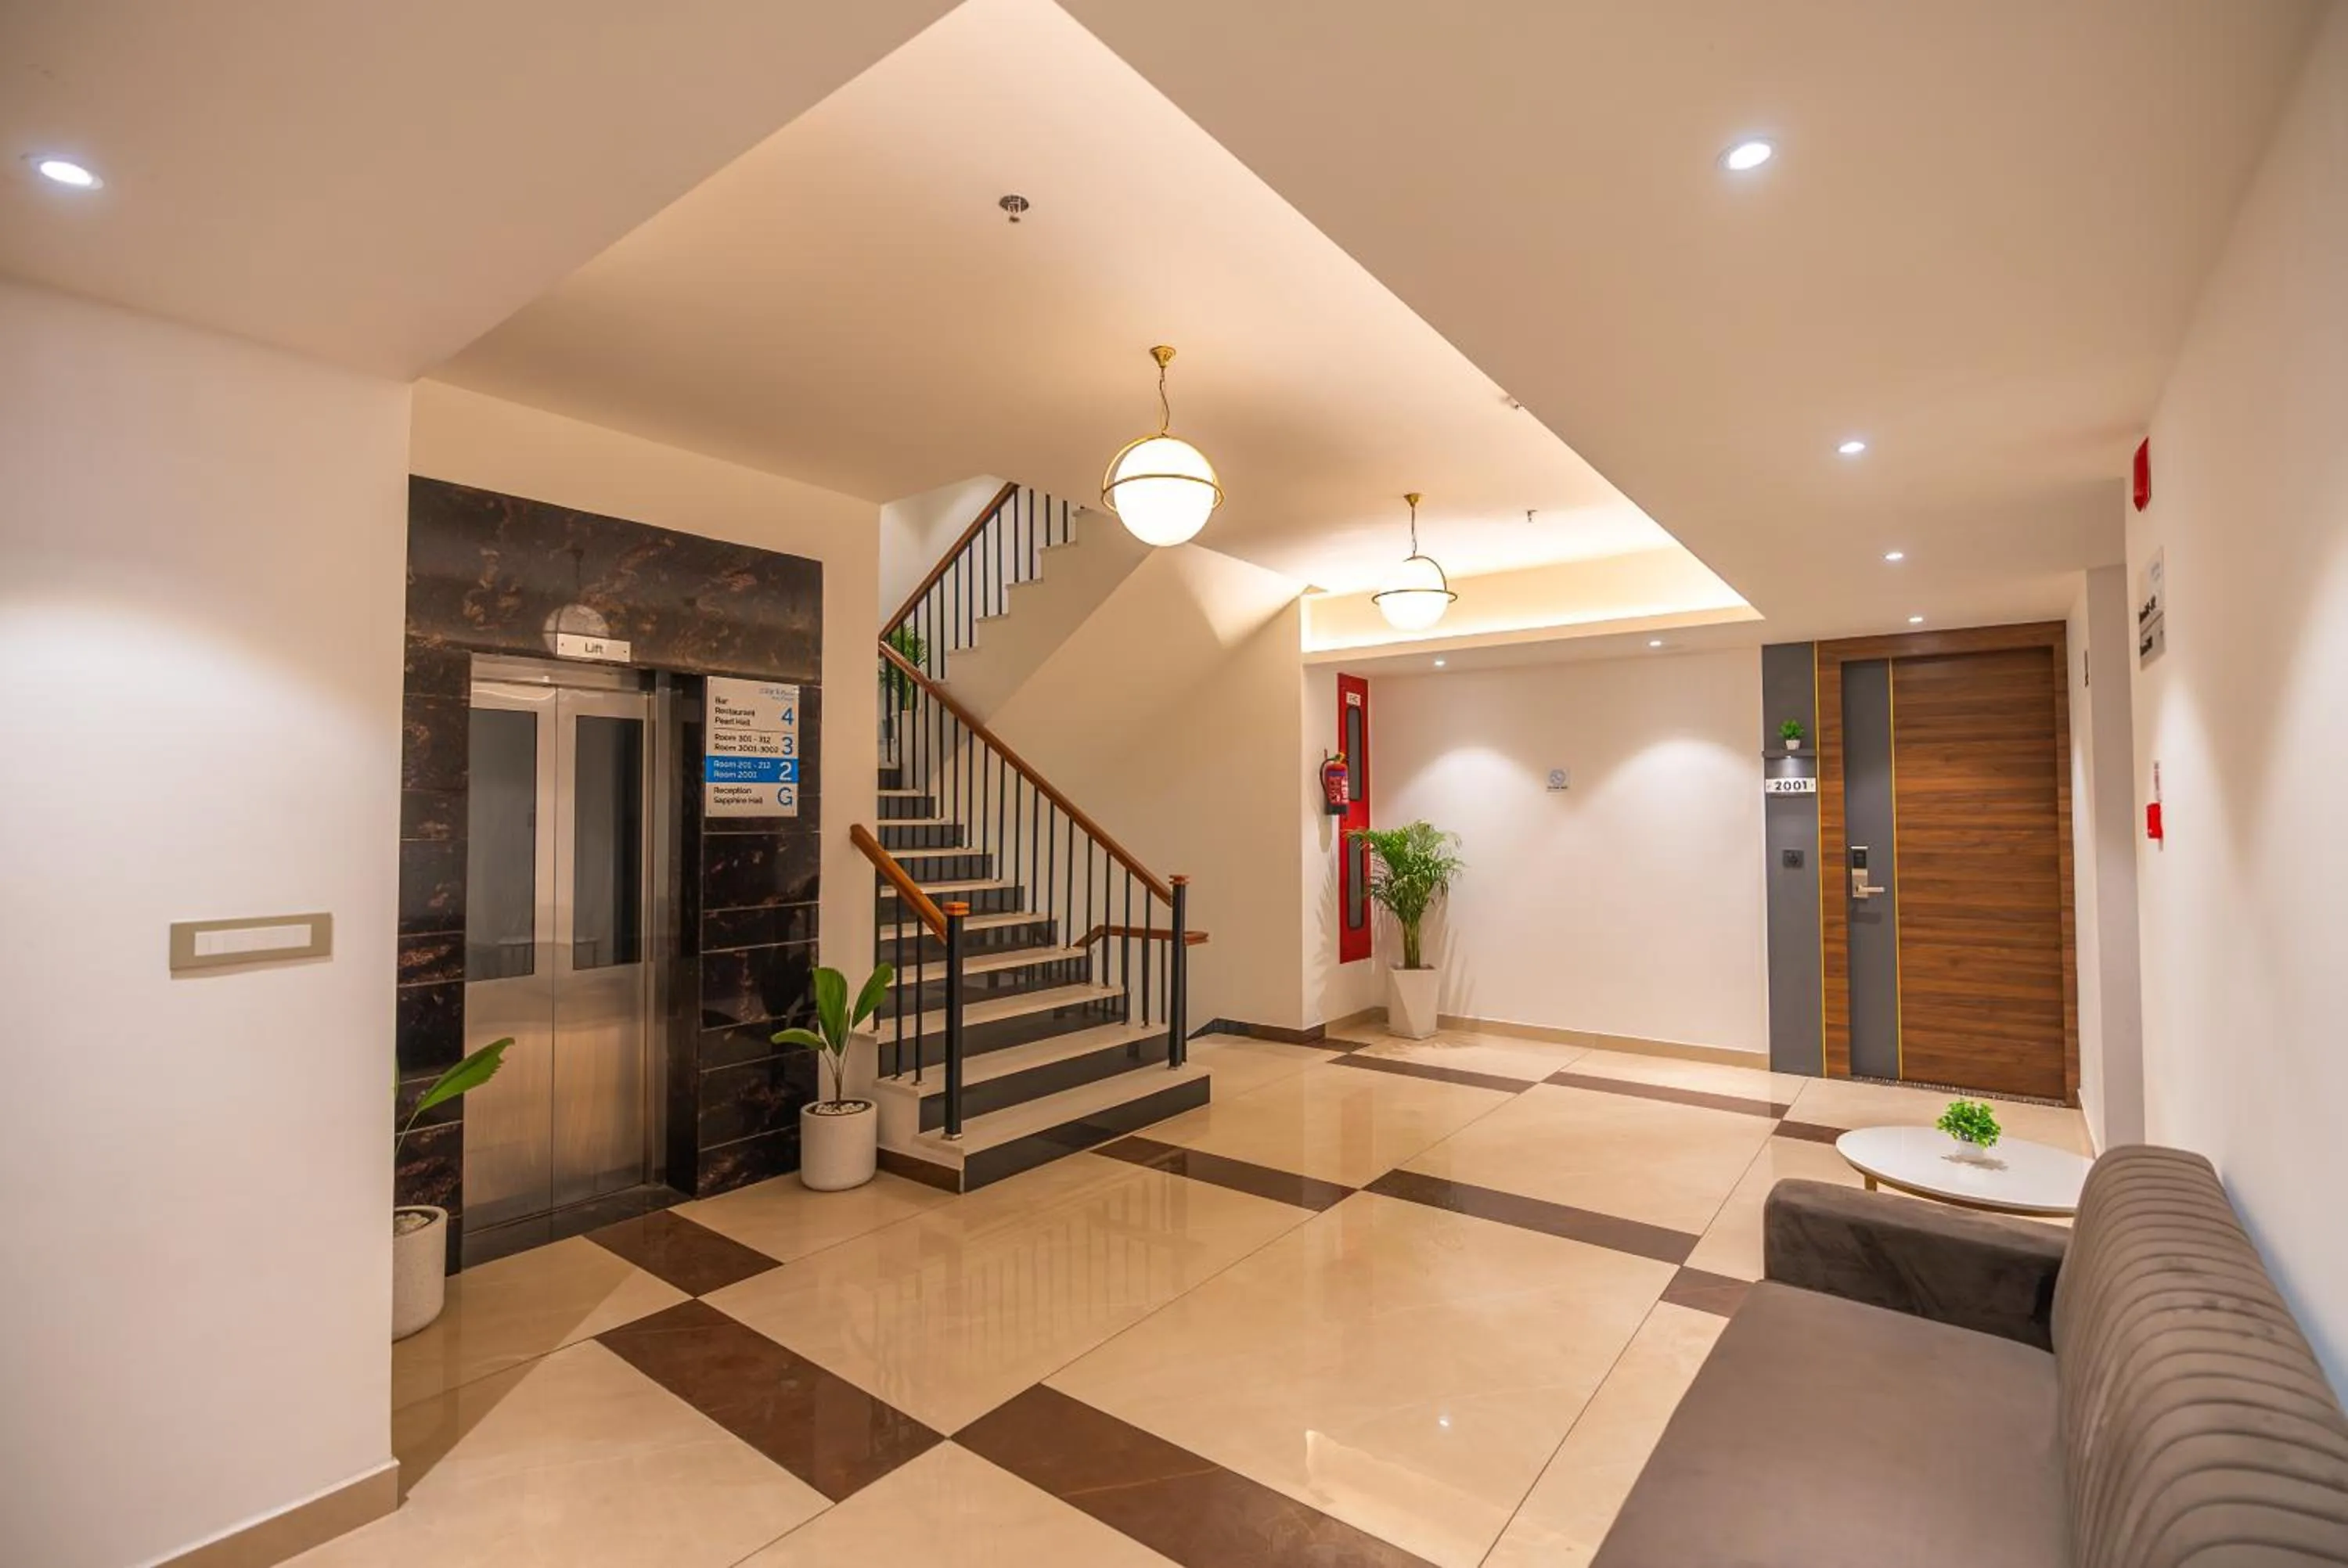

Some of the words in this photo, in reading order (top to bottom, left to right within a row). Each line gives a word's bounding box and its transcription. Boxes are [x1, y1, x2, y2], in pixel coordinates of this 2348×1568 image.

[585, 642, 603, 653] Lift
[715, 696, 728, 704] Bar
[715, 707, 754, 717] Restaurant
[781, 707, 794, 726] 4
[715, 716, 734, 725] Pearl
[736, 717, 751, 726] Hall
[781, 736, 793, 755] 3
[779, 761, 792, 780] 2
[714, 786, 752, 795] Reception
[1774, 780, 1807, 791] 2001
[714, 797, 747, 806] Sapphire
[777, 786, 792, 806] G
